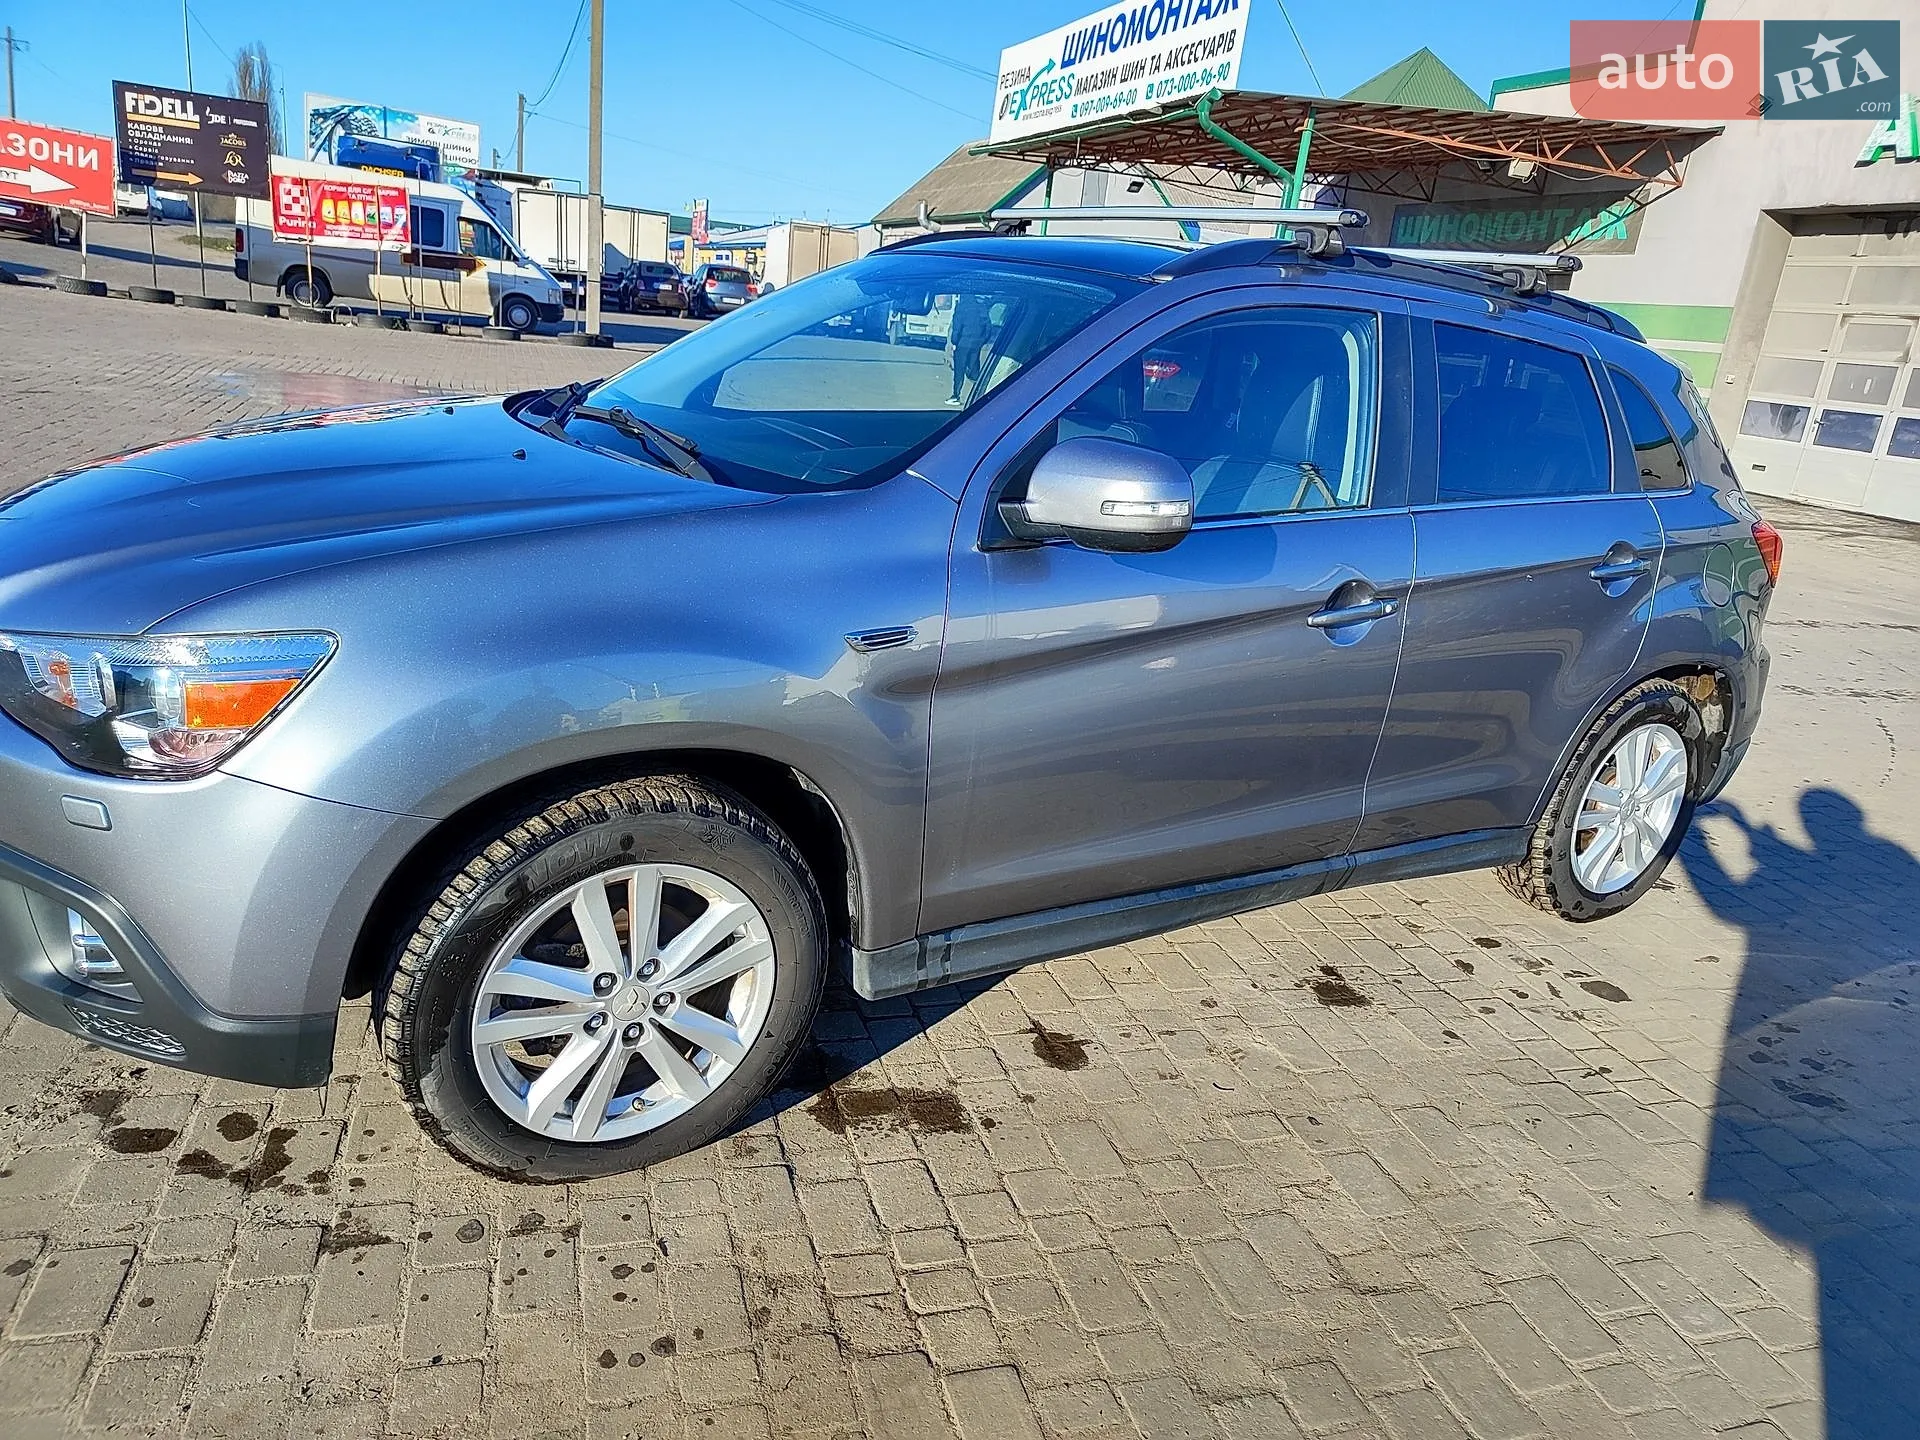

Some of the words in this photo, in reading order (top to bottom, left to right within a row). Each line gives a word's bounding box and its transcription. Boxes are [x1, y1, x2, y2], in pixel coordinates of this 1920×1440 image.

[1074, 64, 1118, 97] МАГАЗИН
[1120, 58, 1148, 84] ШИН
[1149, 53, 1162, 76] ТА
[1164, 29, 1237, 72] АКСЕСУАРІВ
[999, 65, 1031, 90] РЕЗИНА
[1156, 61, 1231, 98] 073-000-96-90
[1079, 88, 1138, 118] 097-009-69-00
[127, 122, 164, 133] КАВОВЕ
[207, 113, 227, 125] JDE
[127, 131, 194, 145] ОБЛАДНАННЯ:
[220, 137, 247, 147] JACOBS
[134, 145, 159, 154] Сервіс
[1396, 204, 1635, 245] ШИНОМОНТАЖ
